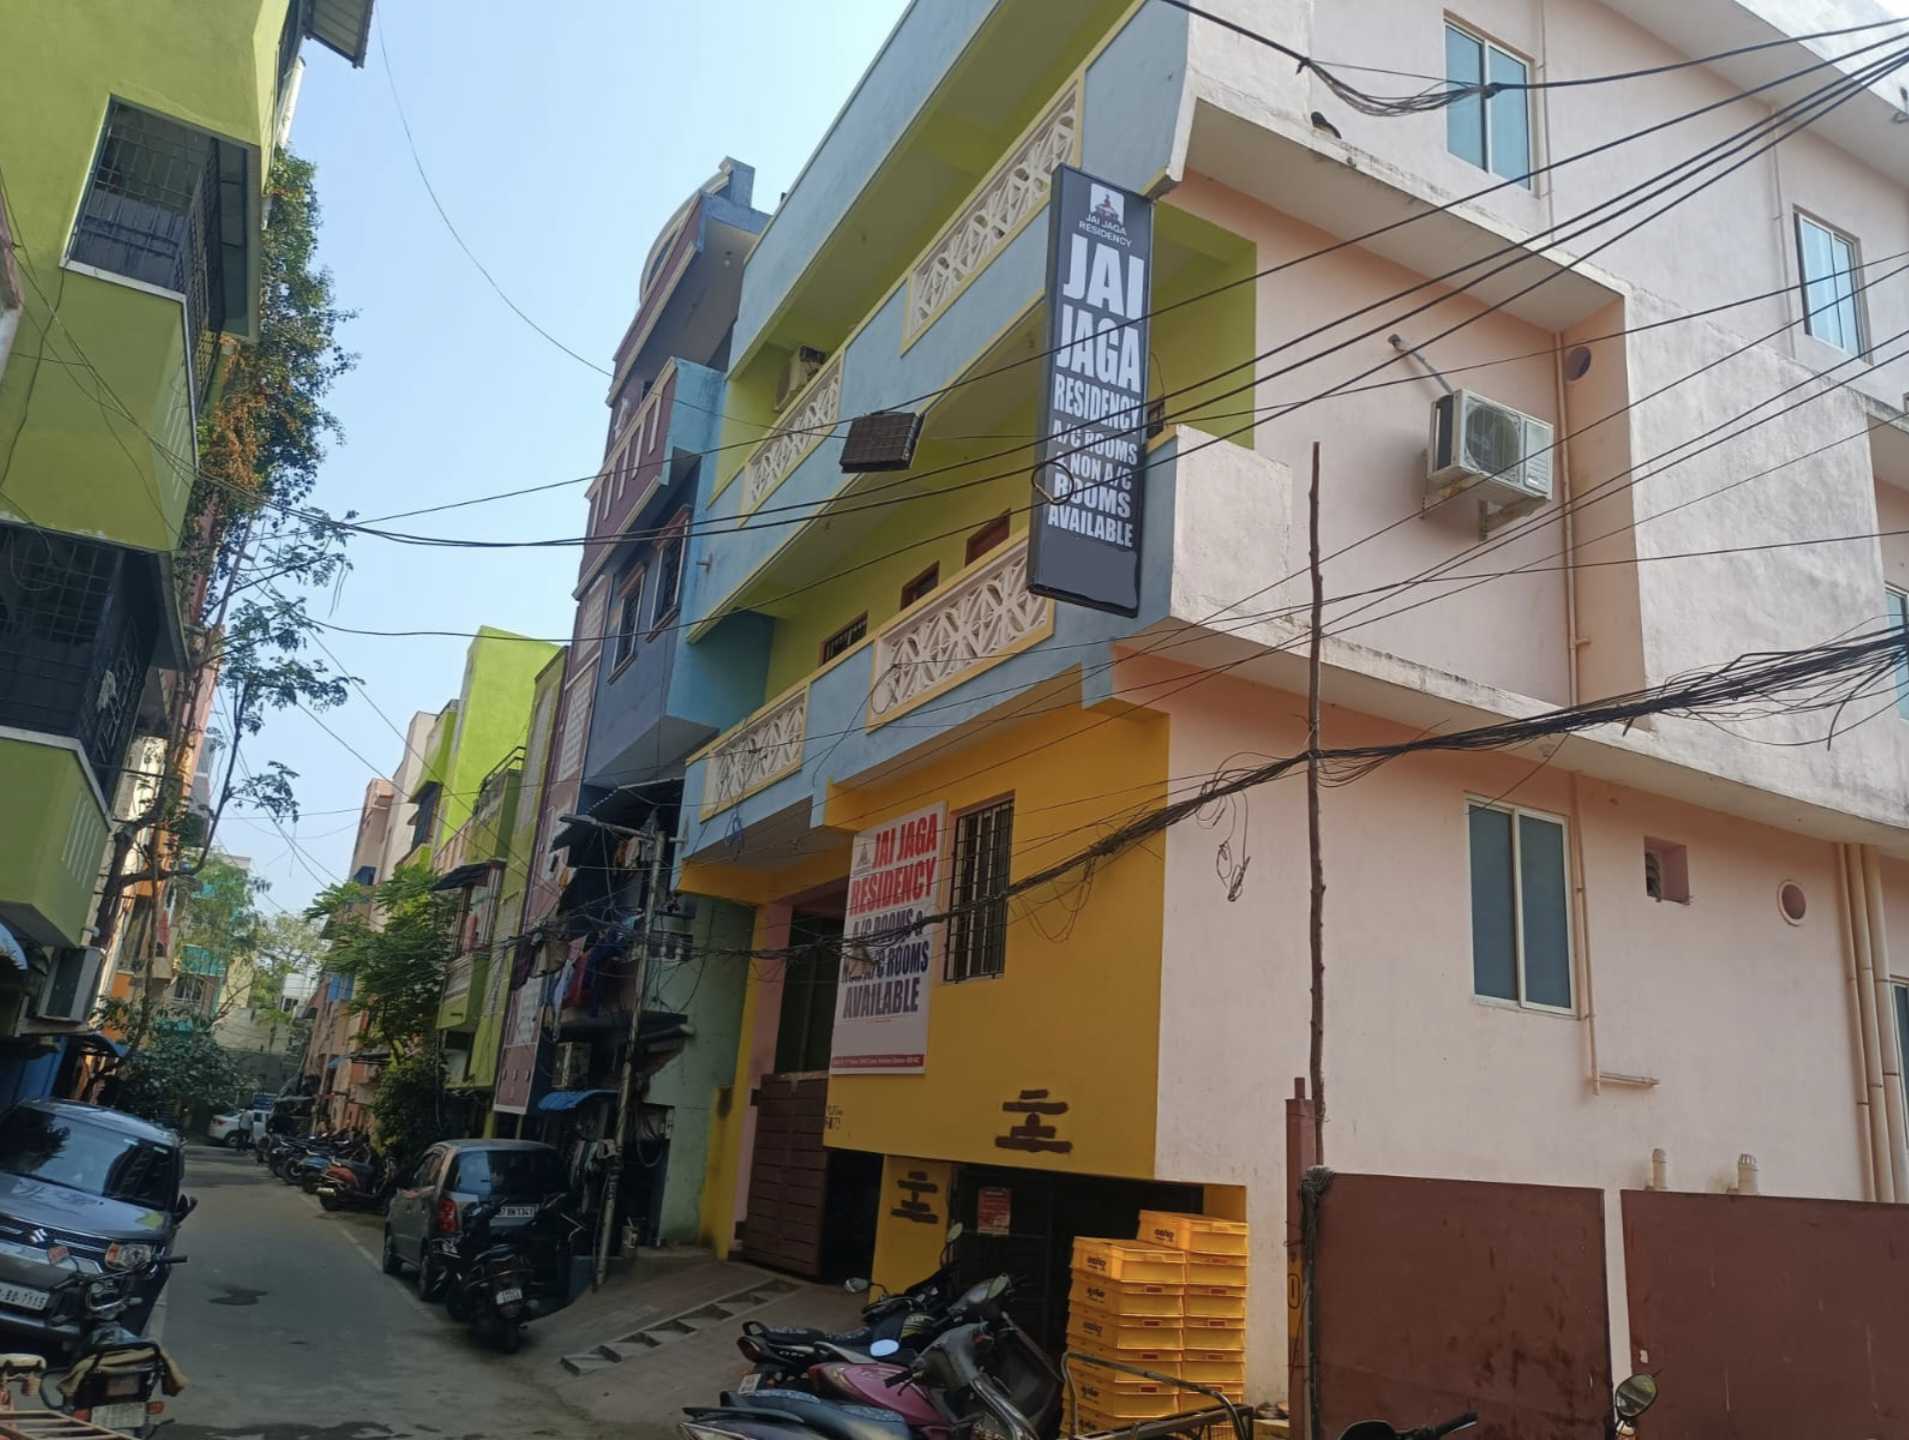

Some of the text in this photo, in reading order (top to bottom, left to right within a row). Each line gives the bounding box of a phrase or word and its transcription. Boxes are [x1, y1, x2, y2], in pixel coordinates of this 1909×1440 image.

[1079, 220, 1133, 248] RESIDENCY
[1062, 233, 1145, 323] JAI
[1056, 303, 1141, 393] JAGA
[1053, 373, 1140, 434] RESIDENCY
[1052, 419, 1138, 466] A/C ROOMS
[1054, 472, 1131, 519] ROOMS
[1070, 453, 1101, 482] NON
[1103, 463, 1133, 491] A/C
[1048, 504, 1133, 548] AVAILABLE
[872, 813, 938, 869] JAI JAGA
[850, 857, 936, 917] RESIDENCY
[886, 941, 929, 977] ROOMS
[843, 977, 920, 1019] AVAILABLE
